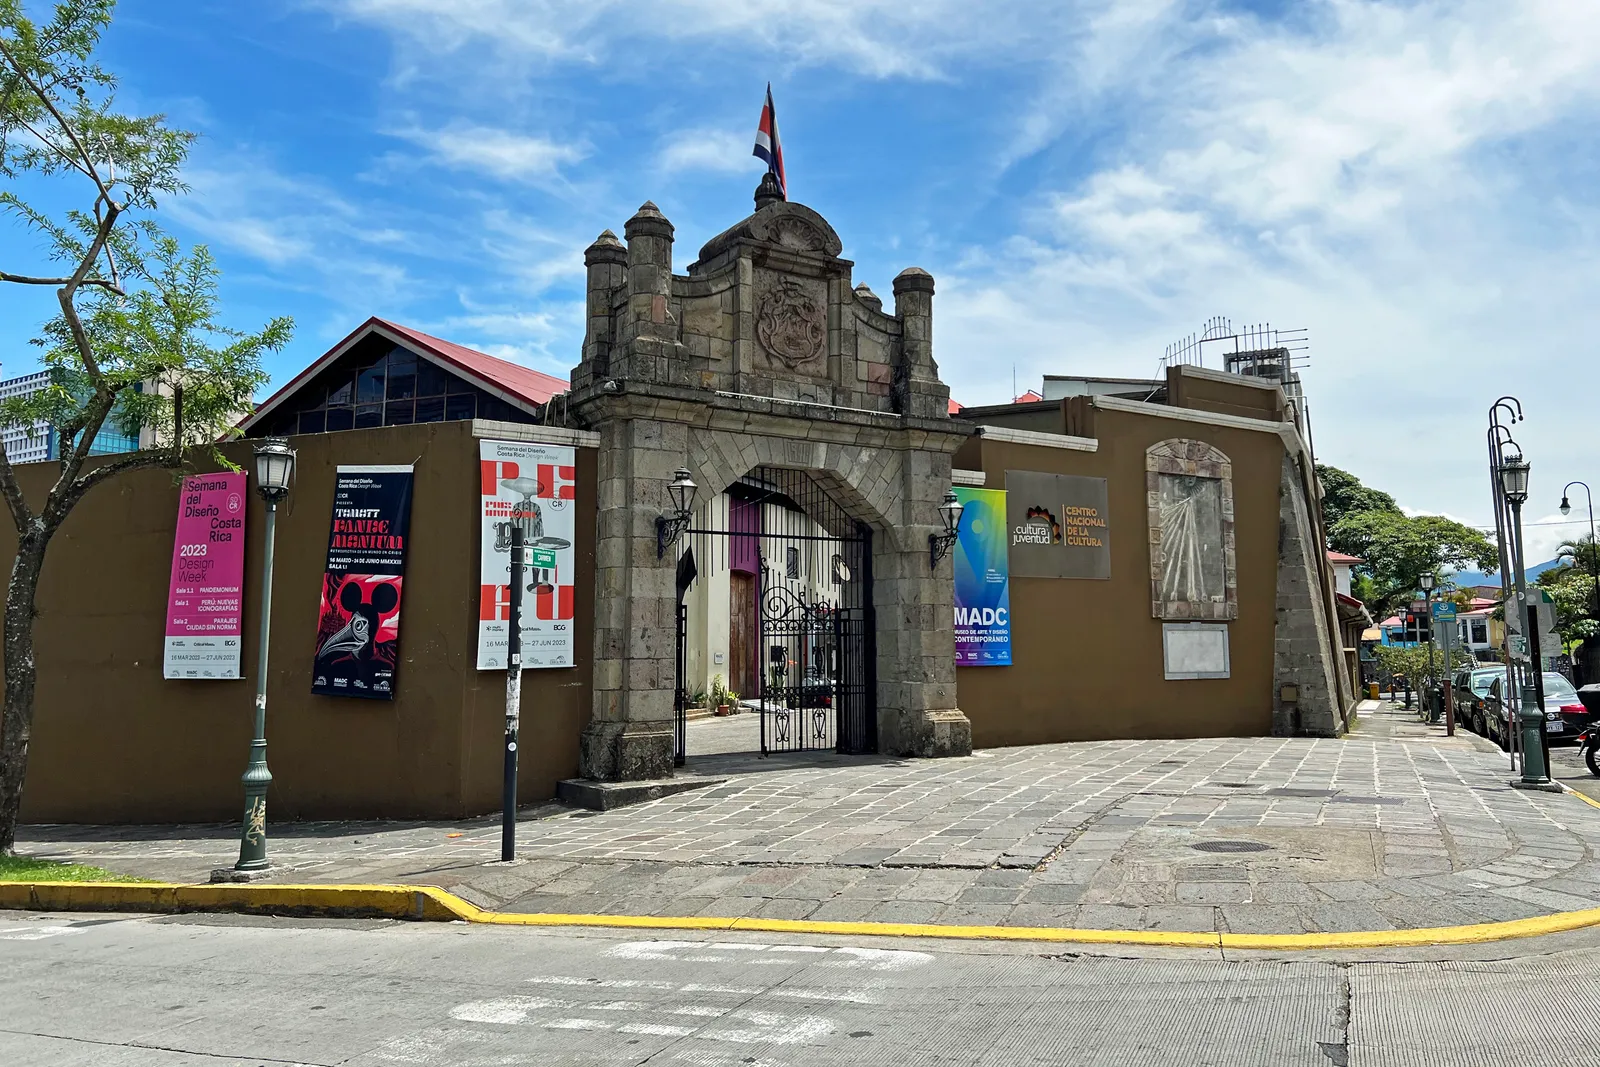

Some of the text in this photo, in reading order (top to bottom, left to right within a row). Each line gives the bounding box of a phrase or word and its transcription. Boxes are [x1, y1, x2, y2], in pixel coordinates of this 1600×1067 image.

[188, 481, 227, 492] Semana
[187, 493, 201, 504] del
[185, 505, 219, 517] Diseño
[1066, 506, 1097, 516] CENTRO
[211, 518, 241, 528] Costa
[1066, 517, 1106, 527] NACIONAL
[1016, 523, 1046, 535] cultura
[1068, 527, 1089, 536] DE LA
[209, 531, 232, 542] Rica
[1012, 531, 1050, 546] juventud
[1068, 537, 1102, 546] CULTURA
[180, 544, 207, 556] 2023
[179, 558, 214, 572] Design
[179, 571, 206, 582] Week
[954, 608, 1007, 626] MADC
